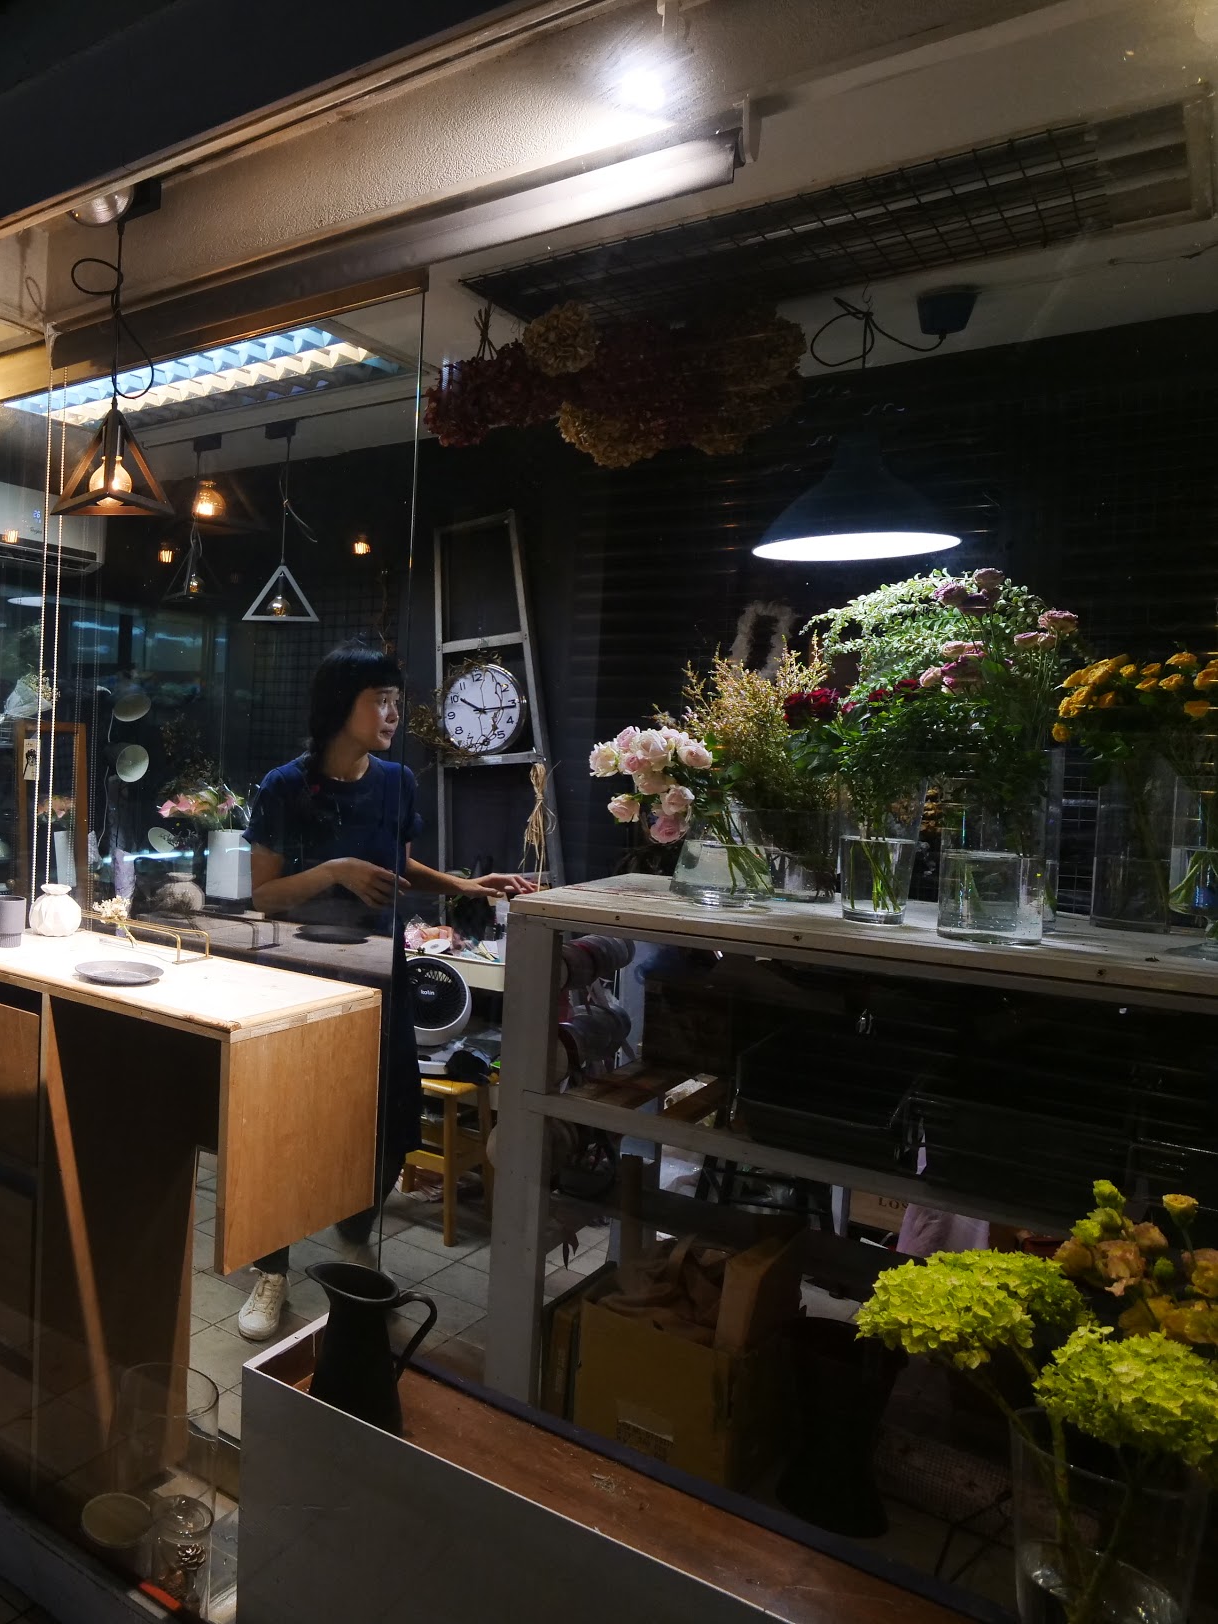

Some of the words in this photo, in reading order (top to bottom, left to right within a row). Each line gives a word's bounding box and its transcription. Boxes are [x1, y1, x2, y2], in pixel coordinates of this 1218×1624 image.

[472, 673, 483, 682] 12
[459, 682, 466, 691] 11
[501, 683, 510, 692] 2
[450, 694, 459, 703] 10
[508, 699, 517, 708] 3
[447, 711, 456, 720] 9
[506, 716, 515, 725] 4
[454, 726, 464, 735] 8
[496, 730, 506, 740] 5
